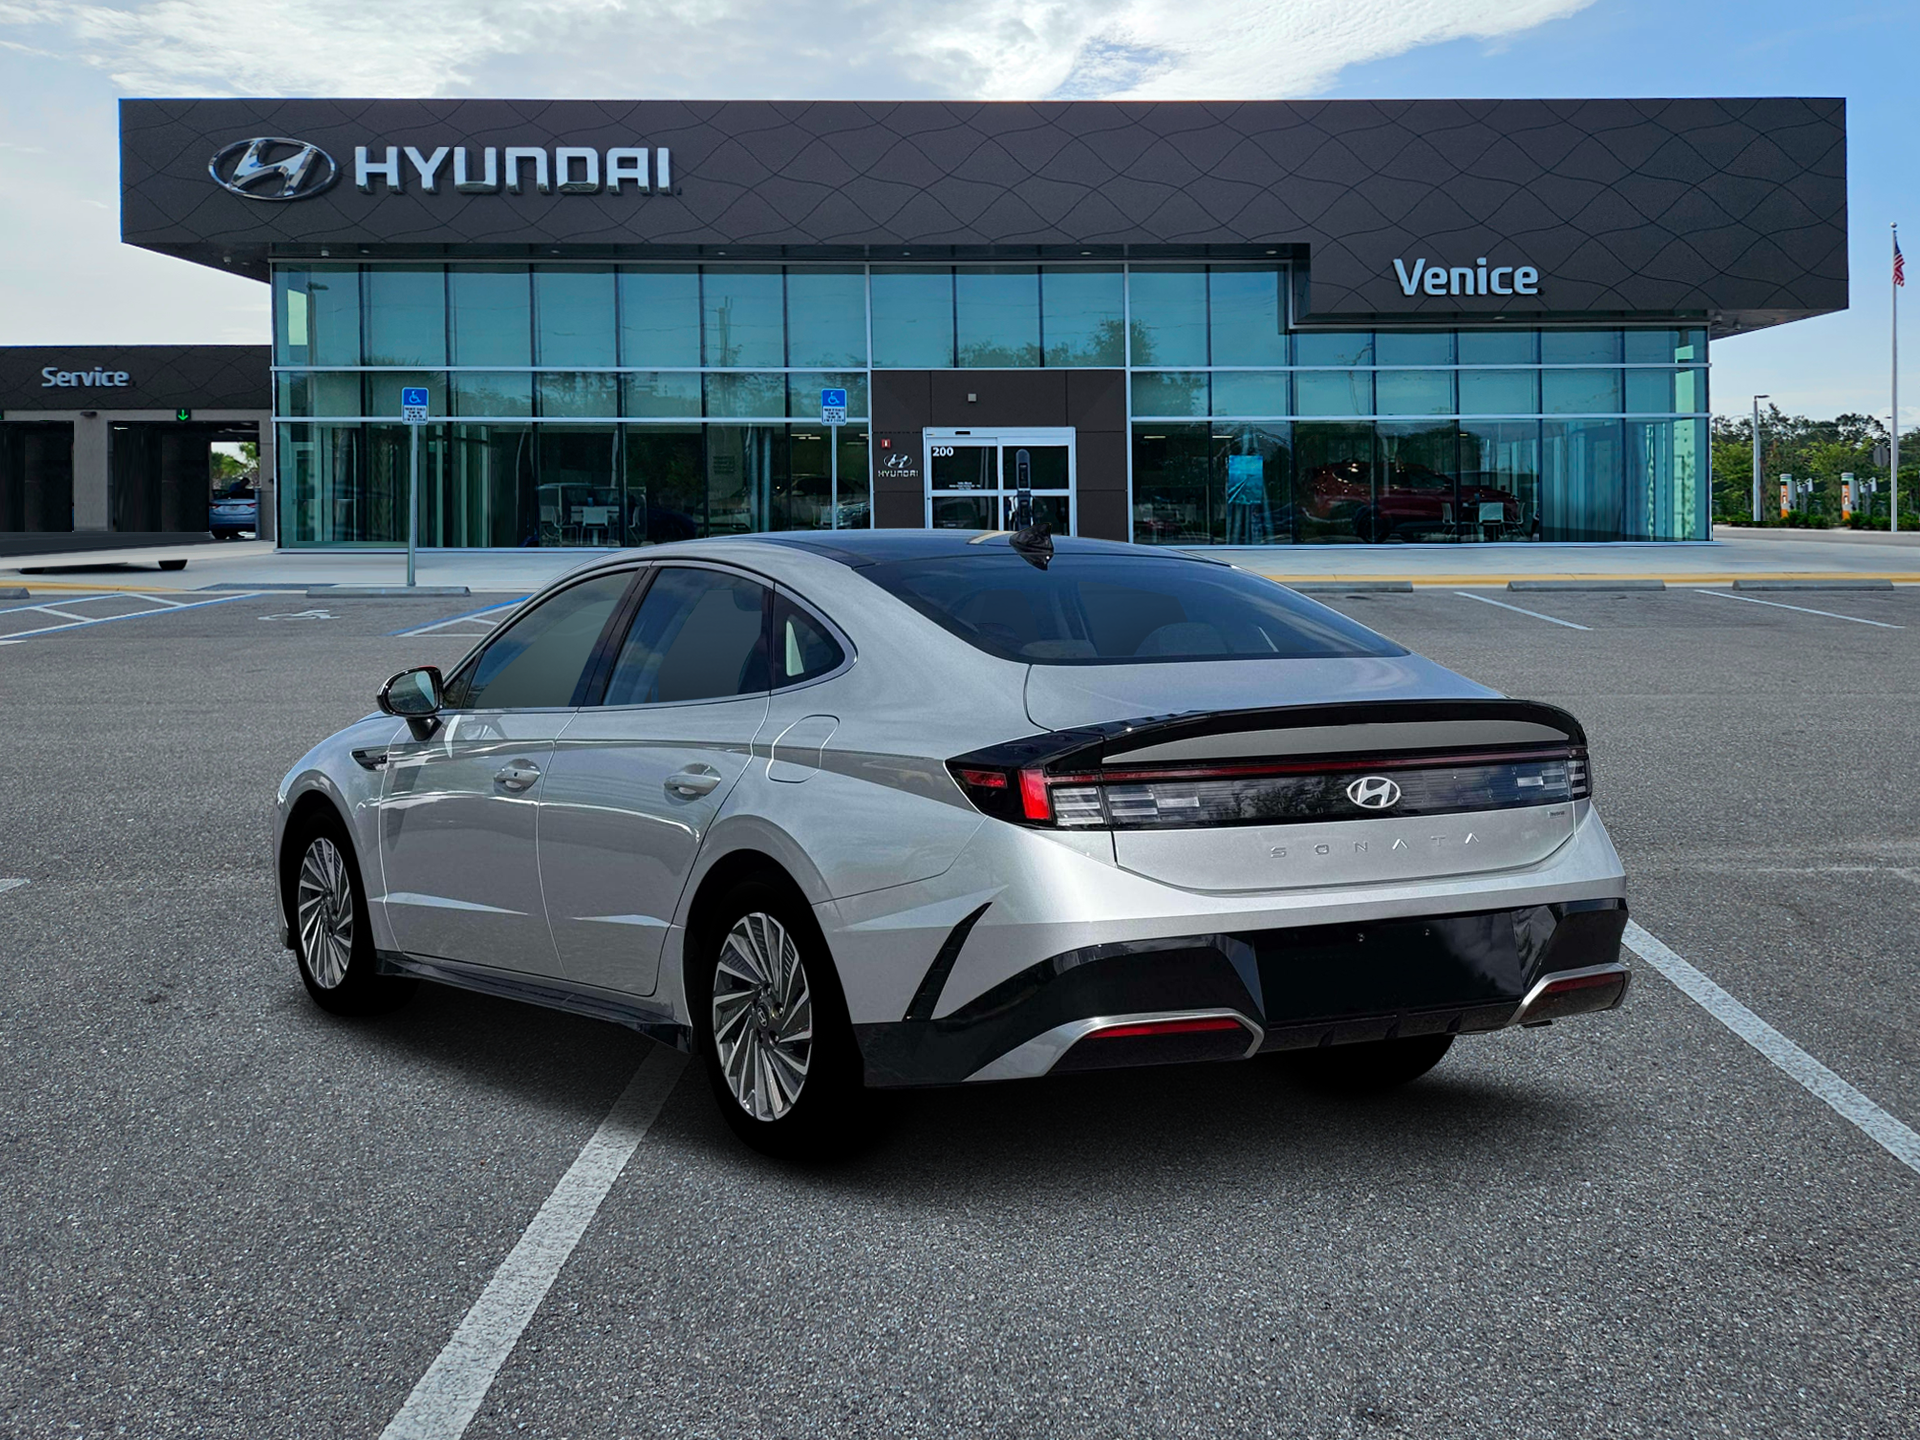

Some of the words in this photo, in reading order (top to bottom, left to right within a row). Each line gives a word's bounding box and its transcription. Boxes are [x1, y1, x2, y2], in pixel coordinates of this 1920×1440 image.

[354, 145, 673, 195] HYUNDAI
[1392, 256, 1539, 297] Venice
[41, 366, 130, 387] Service
[932, 446, 954, 457] 200
[877, 469, 919, 478] HYUNDAI
[1270, 832, 1480, 858] SONATA
